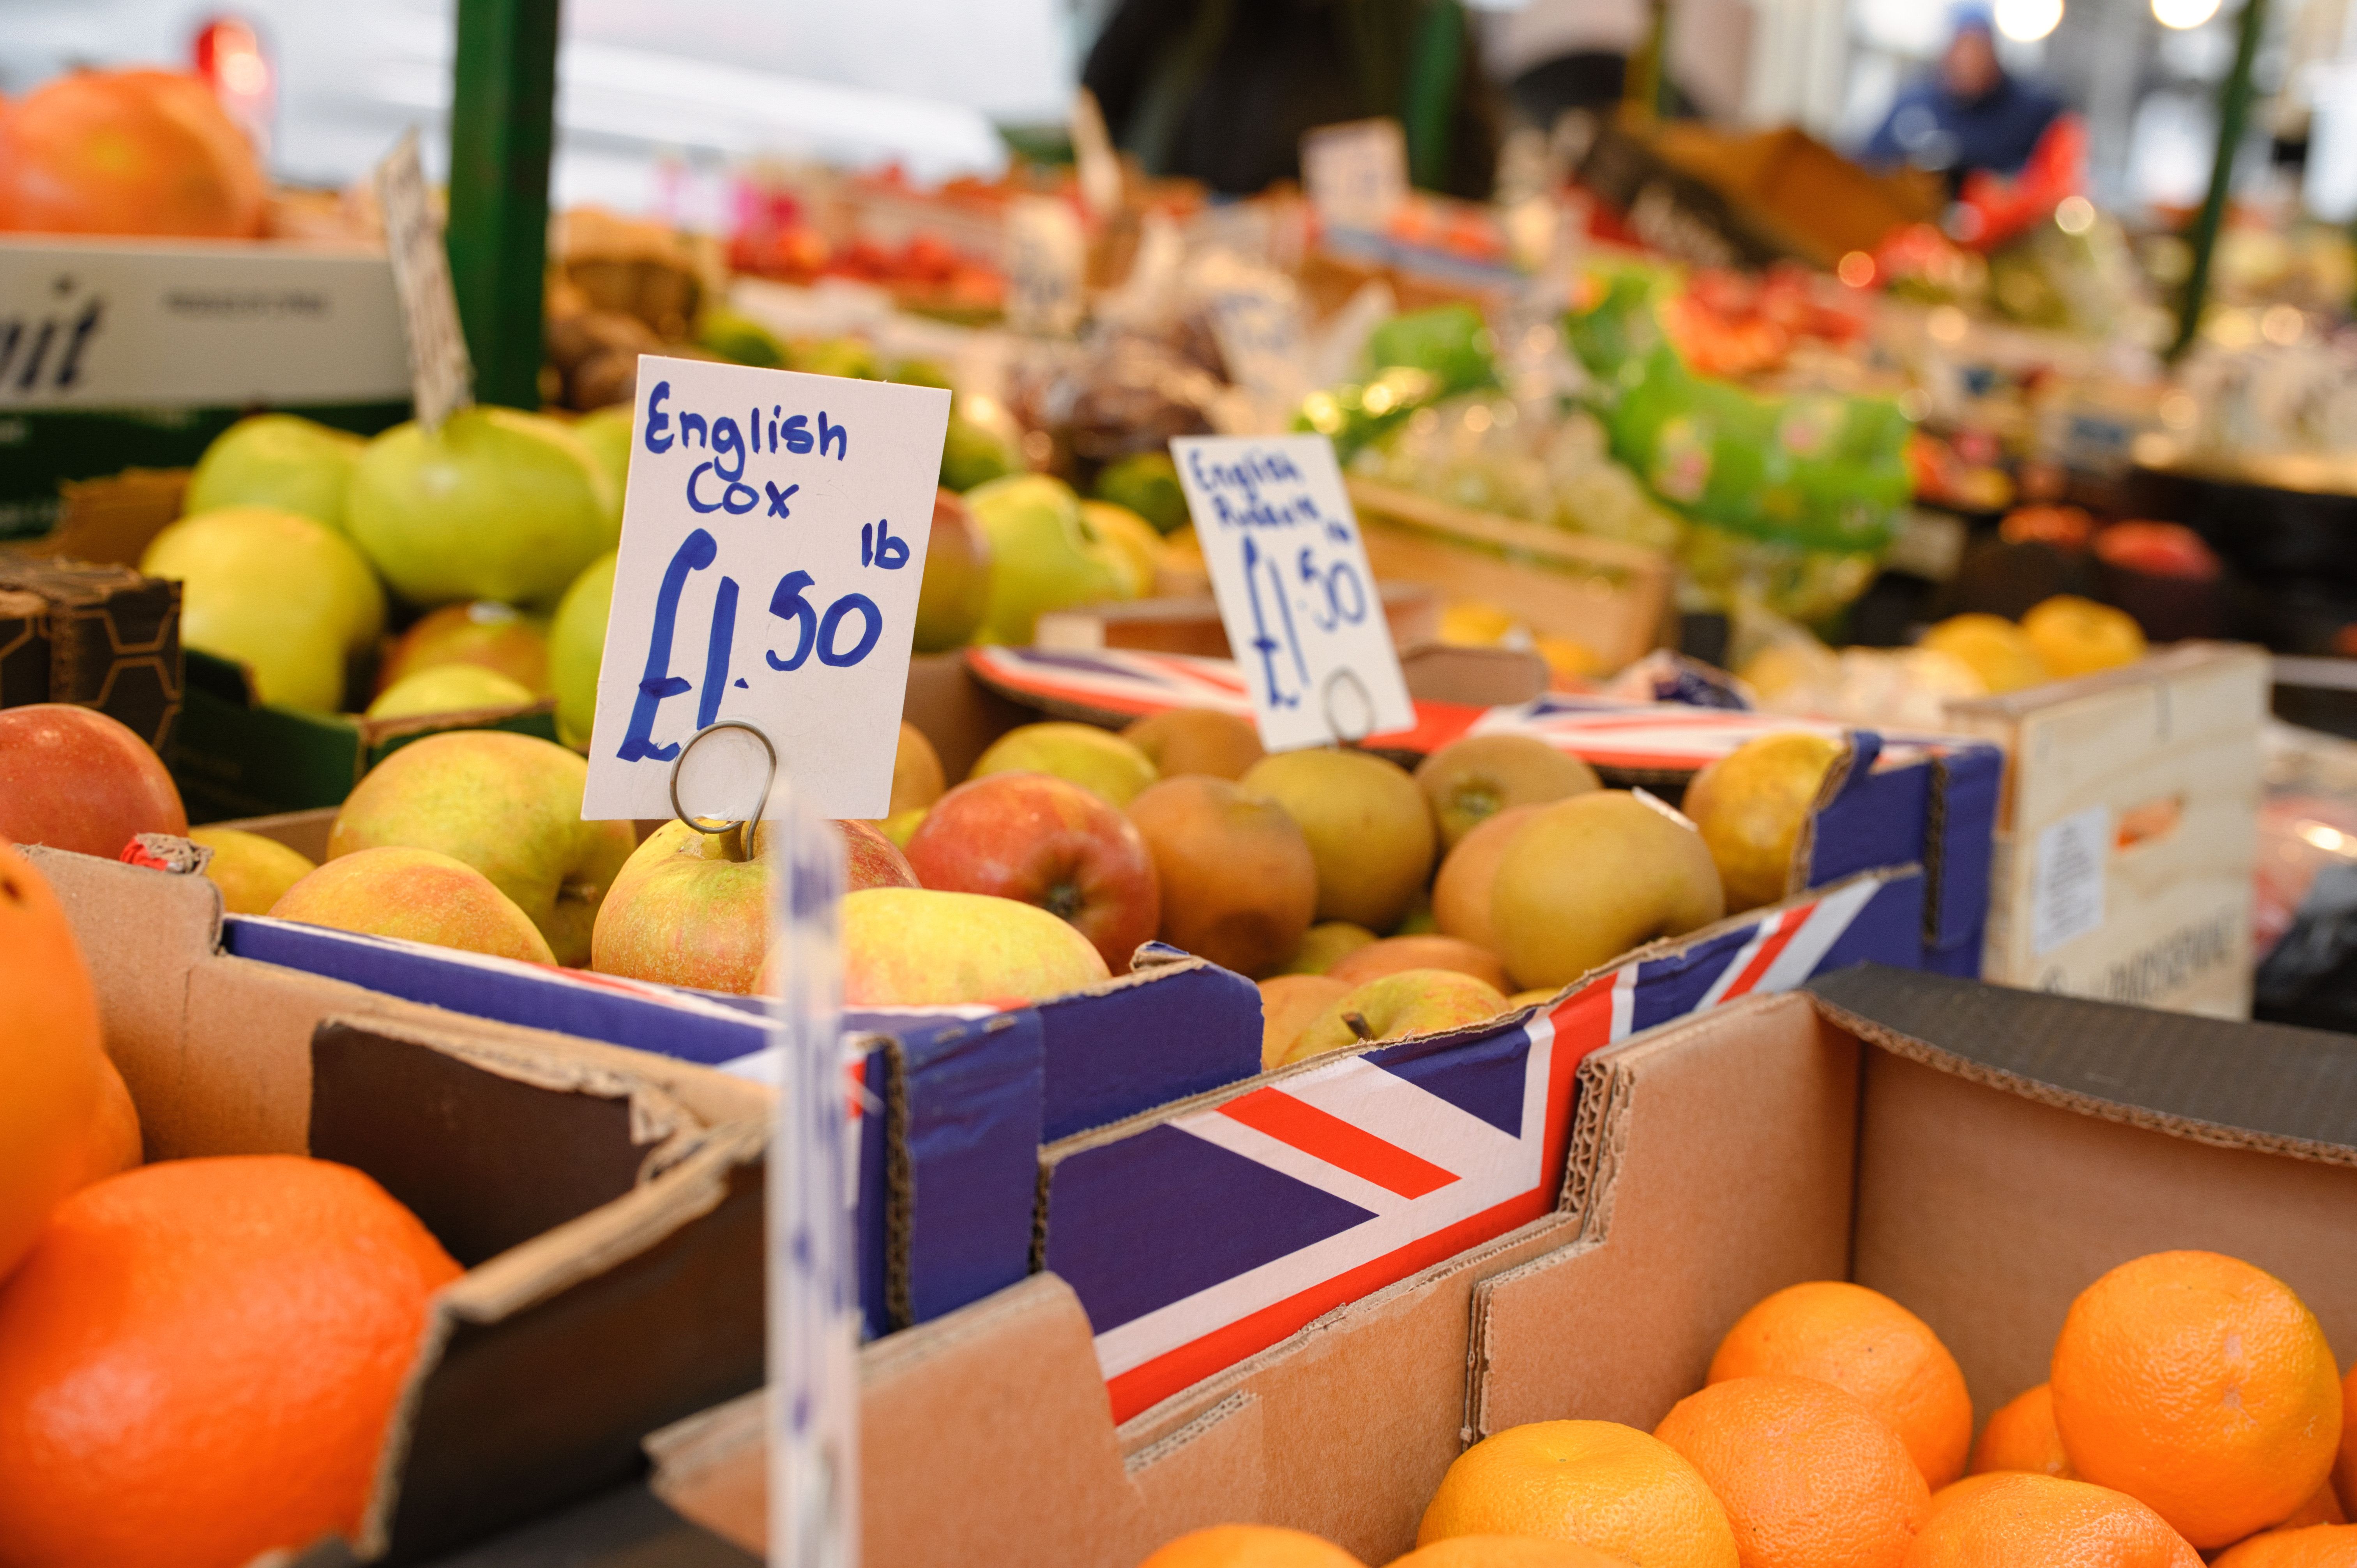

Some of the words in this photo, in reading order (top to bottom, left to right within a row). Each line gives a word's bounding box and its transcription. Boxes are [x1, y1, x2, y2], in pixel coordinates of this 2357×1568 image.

[645, 381, 847, 482] English
[687, 462, 800, 519] Cox
[1188, 447, 1304, 503] English
[617, 528, 883, 762] £1.50
[861, 519, 910, 570] lb
